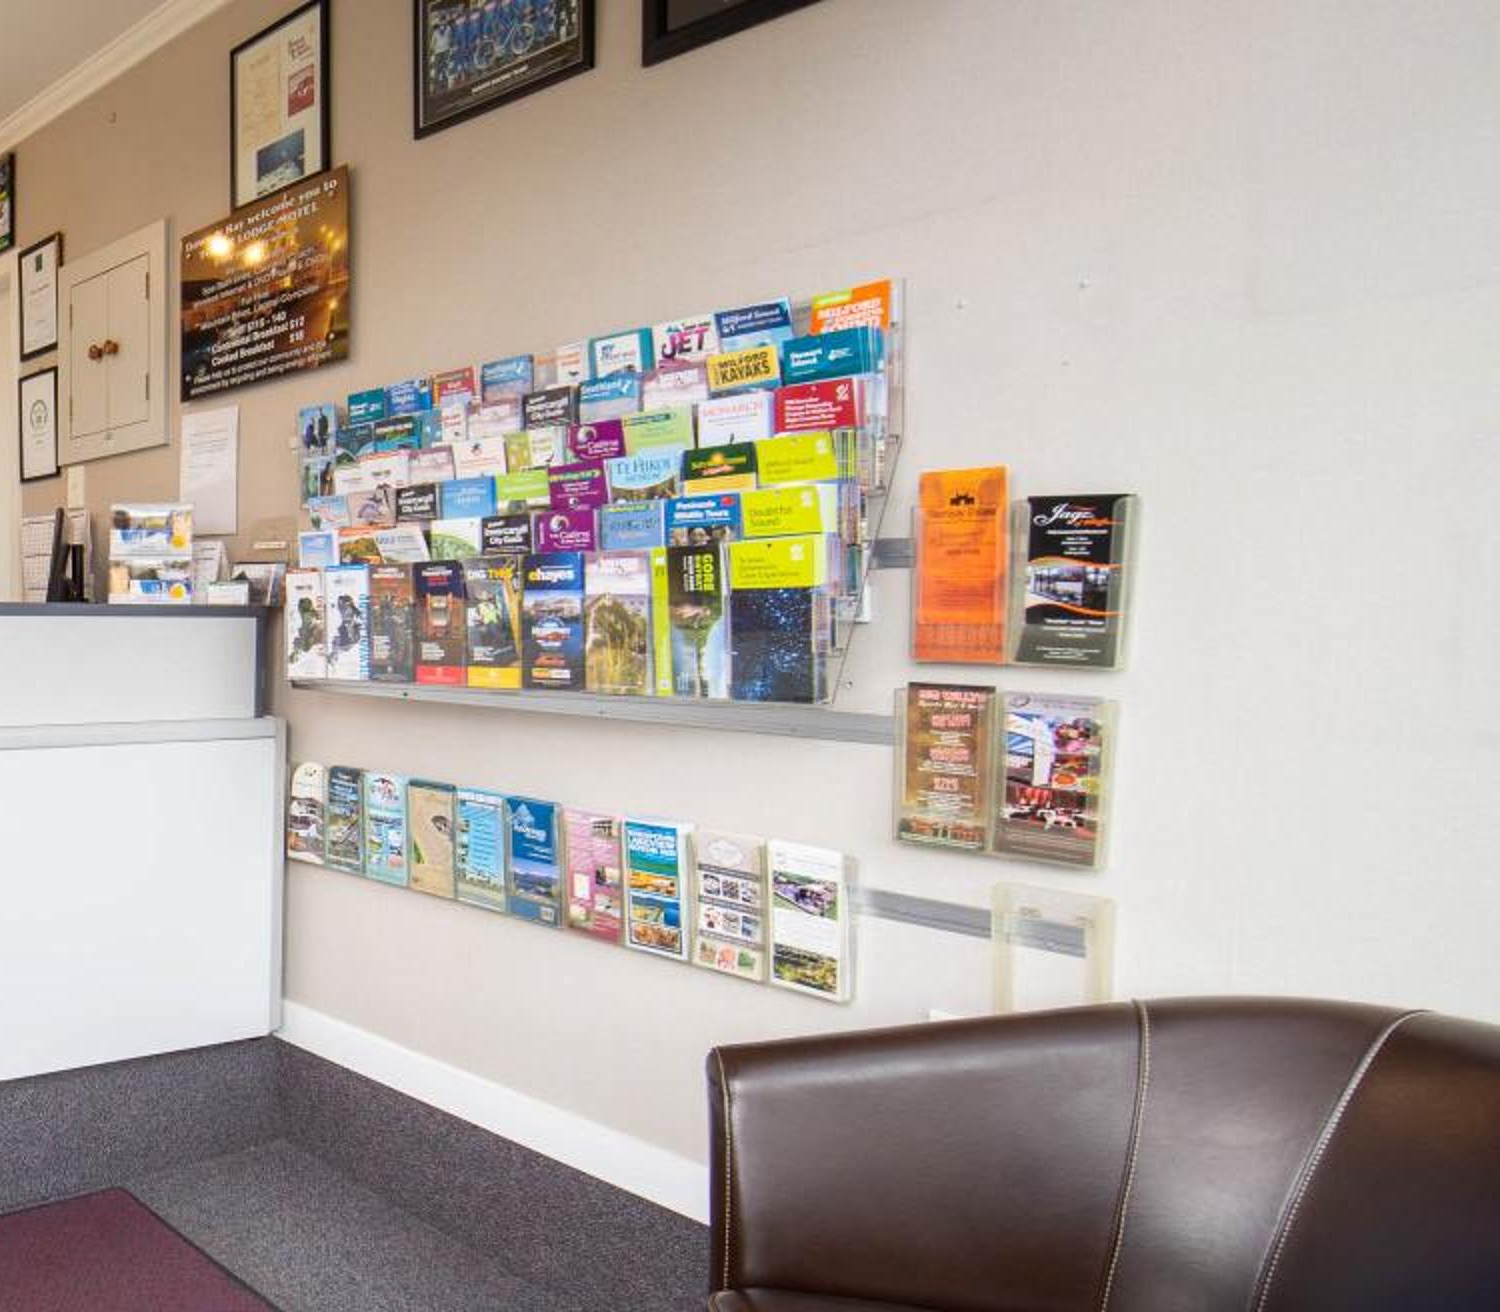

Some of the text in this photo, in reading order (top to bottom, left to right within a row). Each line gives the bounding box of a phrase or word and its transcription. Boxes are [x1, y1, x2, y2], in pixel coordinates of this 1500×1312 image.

[247, 195, 293, 225] welcome
[298, 185, 319, 203] you
[323, 176, 336, 191] to
[253, 320, 288, 341] Breakfast
[661, 327, 708, 359] JET
[211, 349, 238, 367] Cooked
[239, 338, 274, 358] Breakfast
[722, 360, 772, 382] KAYAKS
[489, 534, 502, 546] City
[703, 554, 715, 591] GORE
